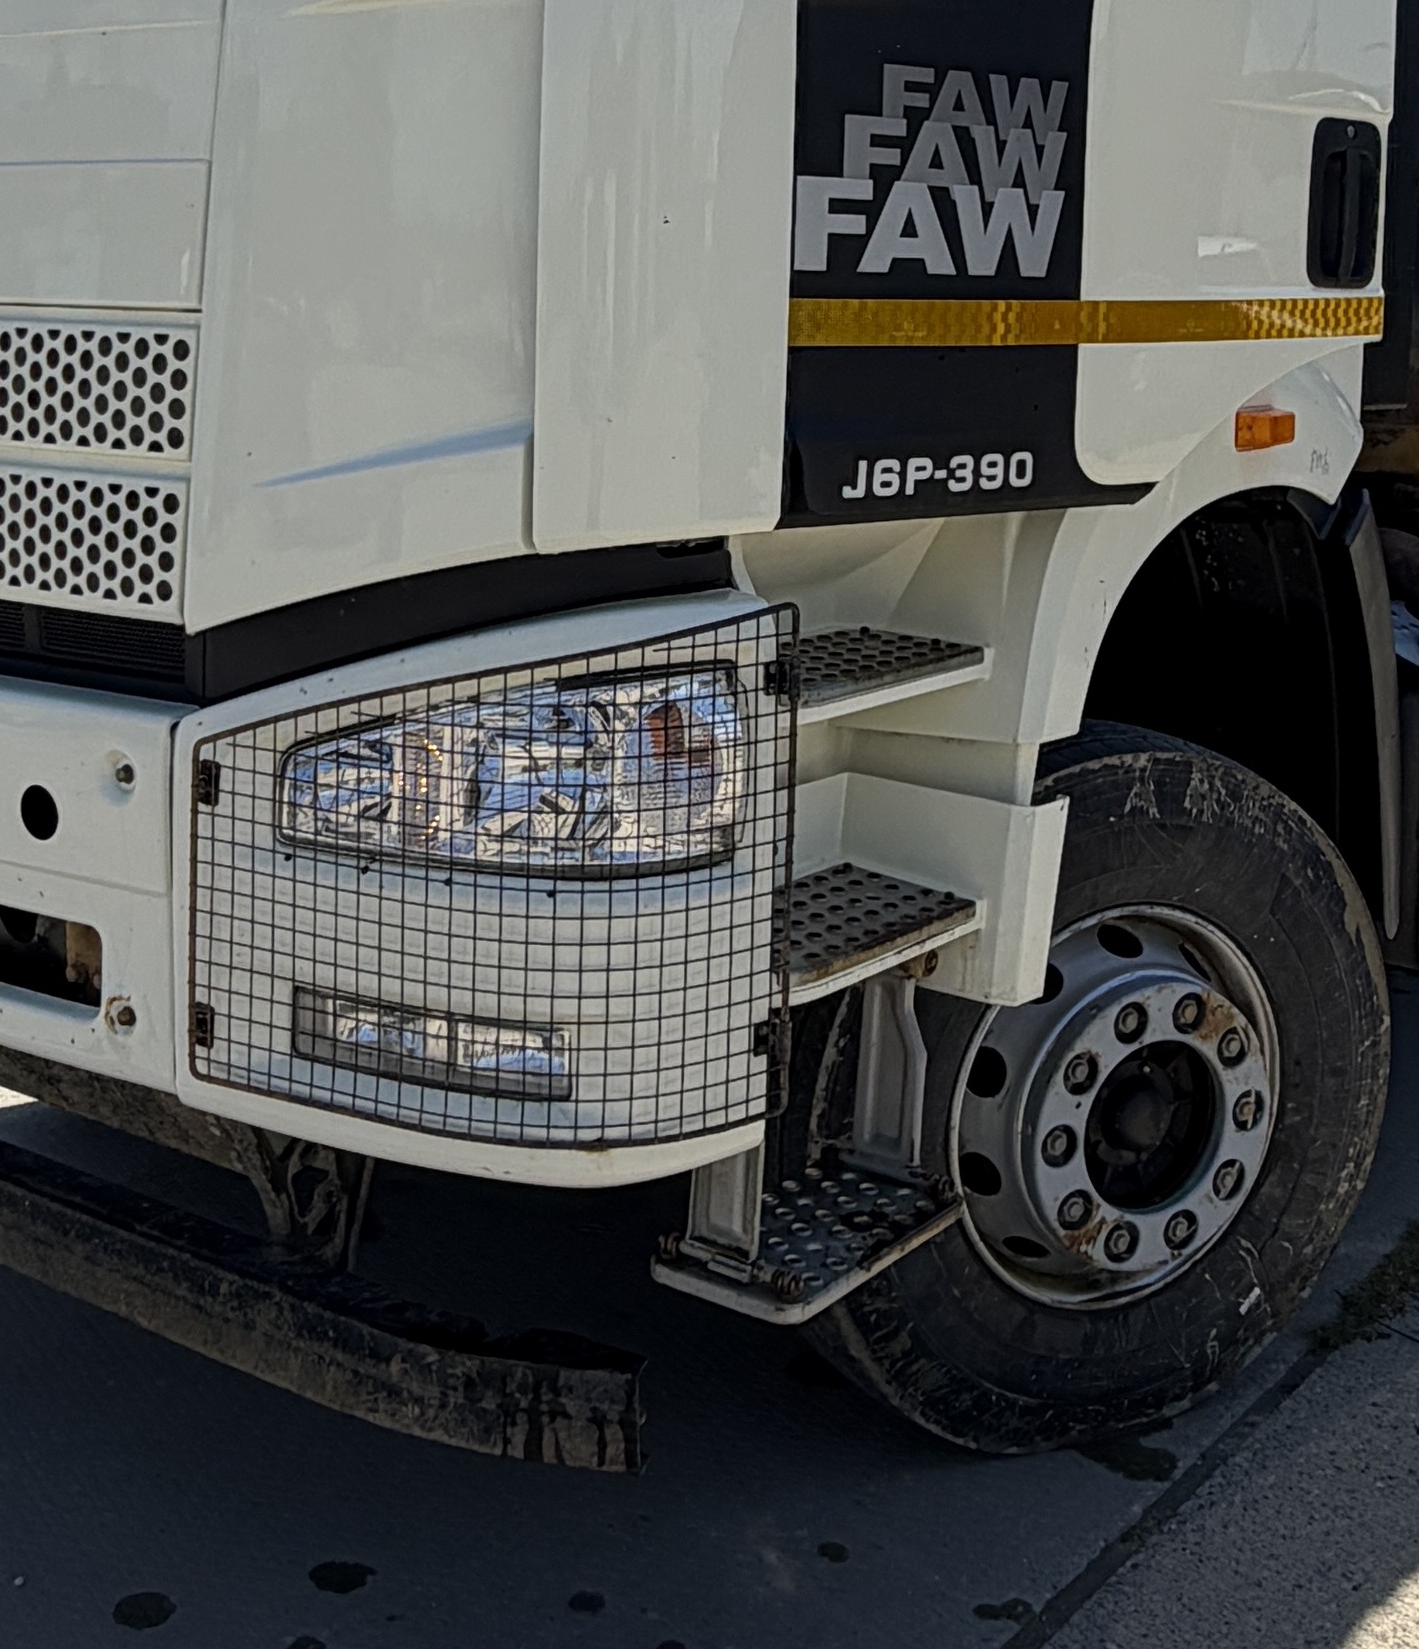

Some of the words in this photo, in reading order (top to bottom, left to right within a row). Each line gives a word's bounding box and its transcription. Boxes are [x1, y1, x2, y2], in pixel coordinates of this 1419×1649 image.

[882, 63, 1069, 145] FAW
[843, 114, 1068, 204] FAW
[794, 175, 1065, 277] FAW
[842, 451, 1033, 499] J6P-390
